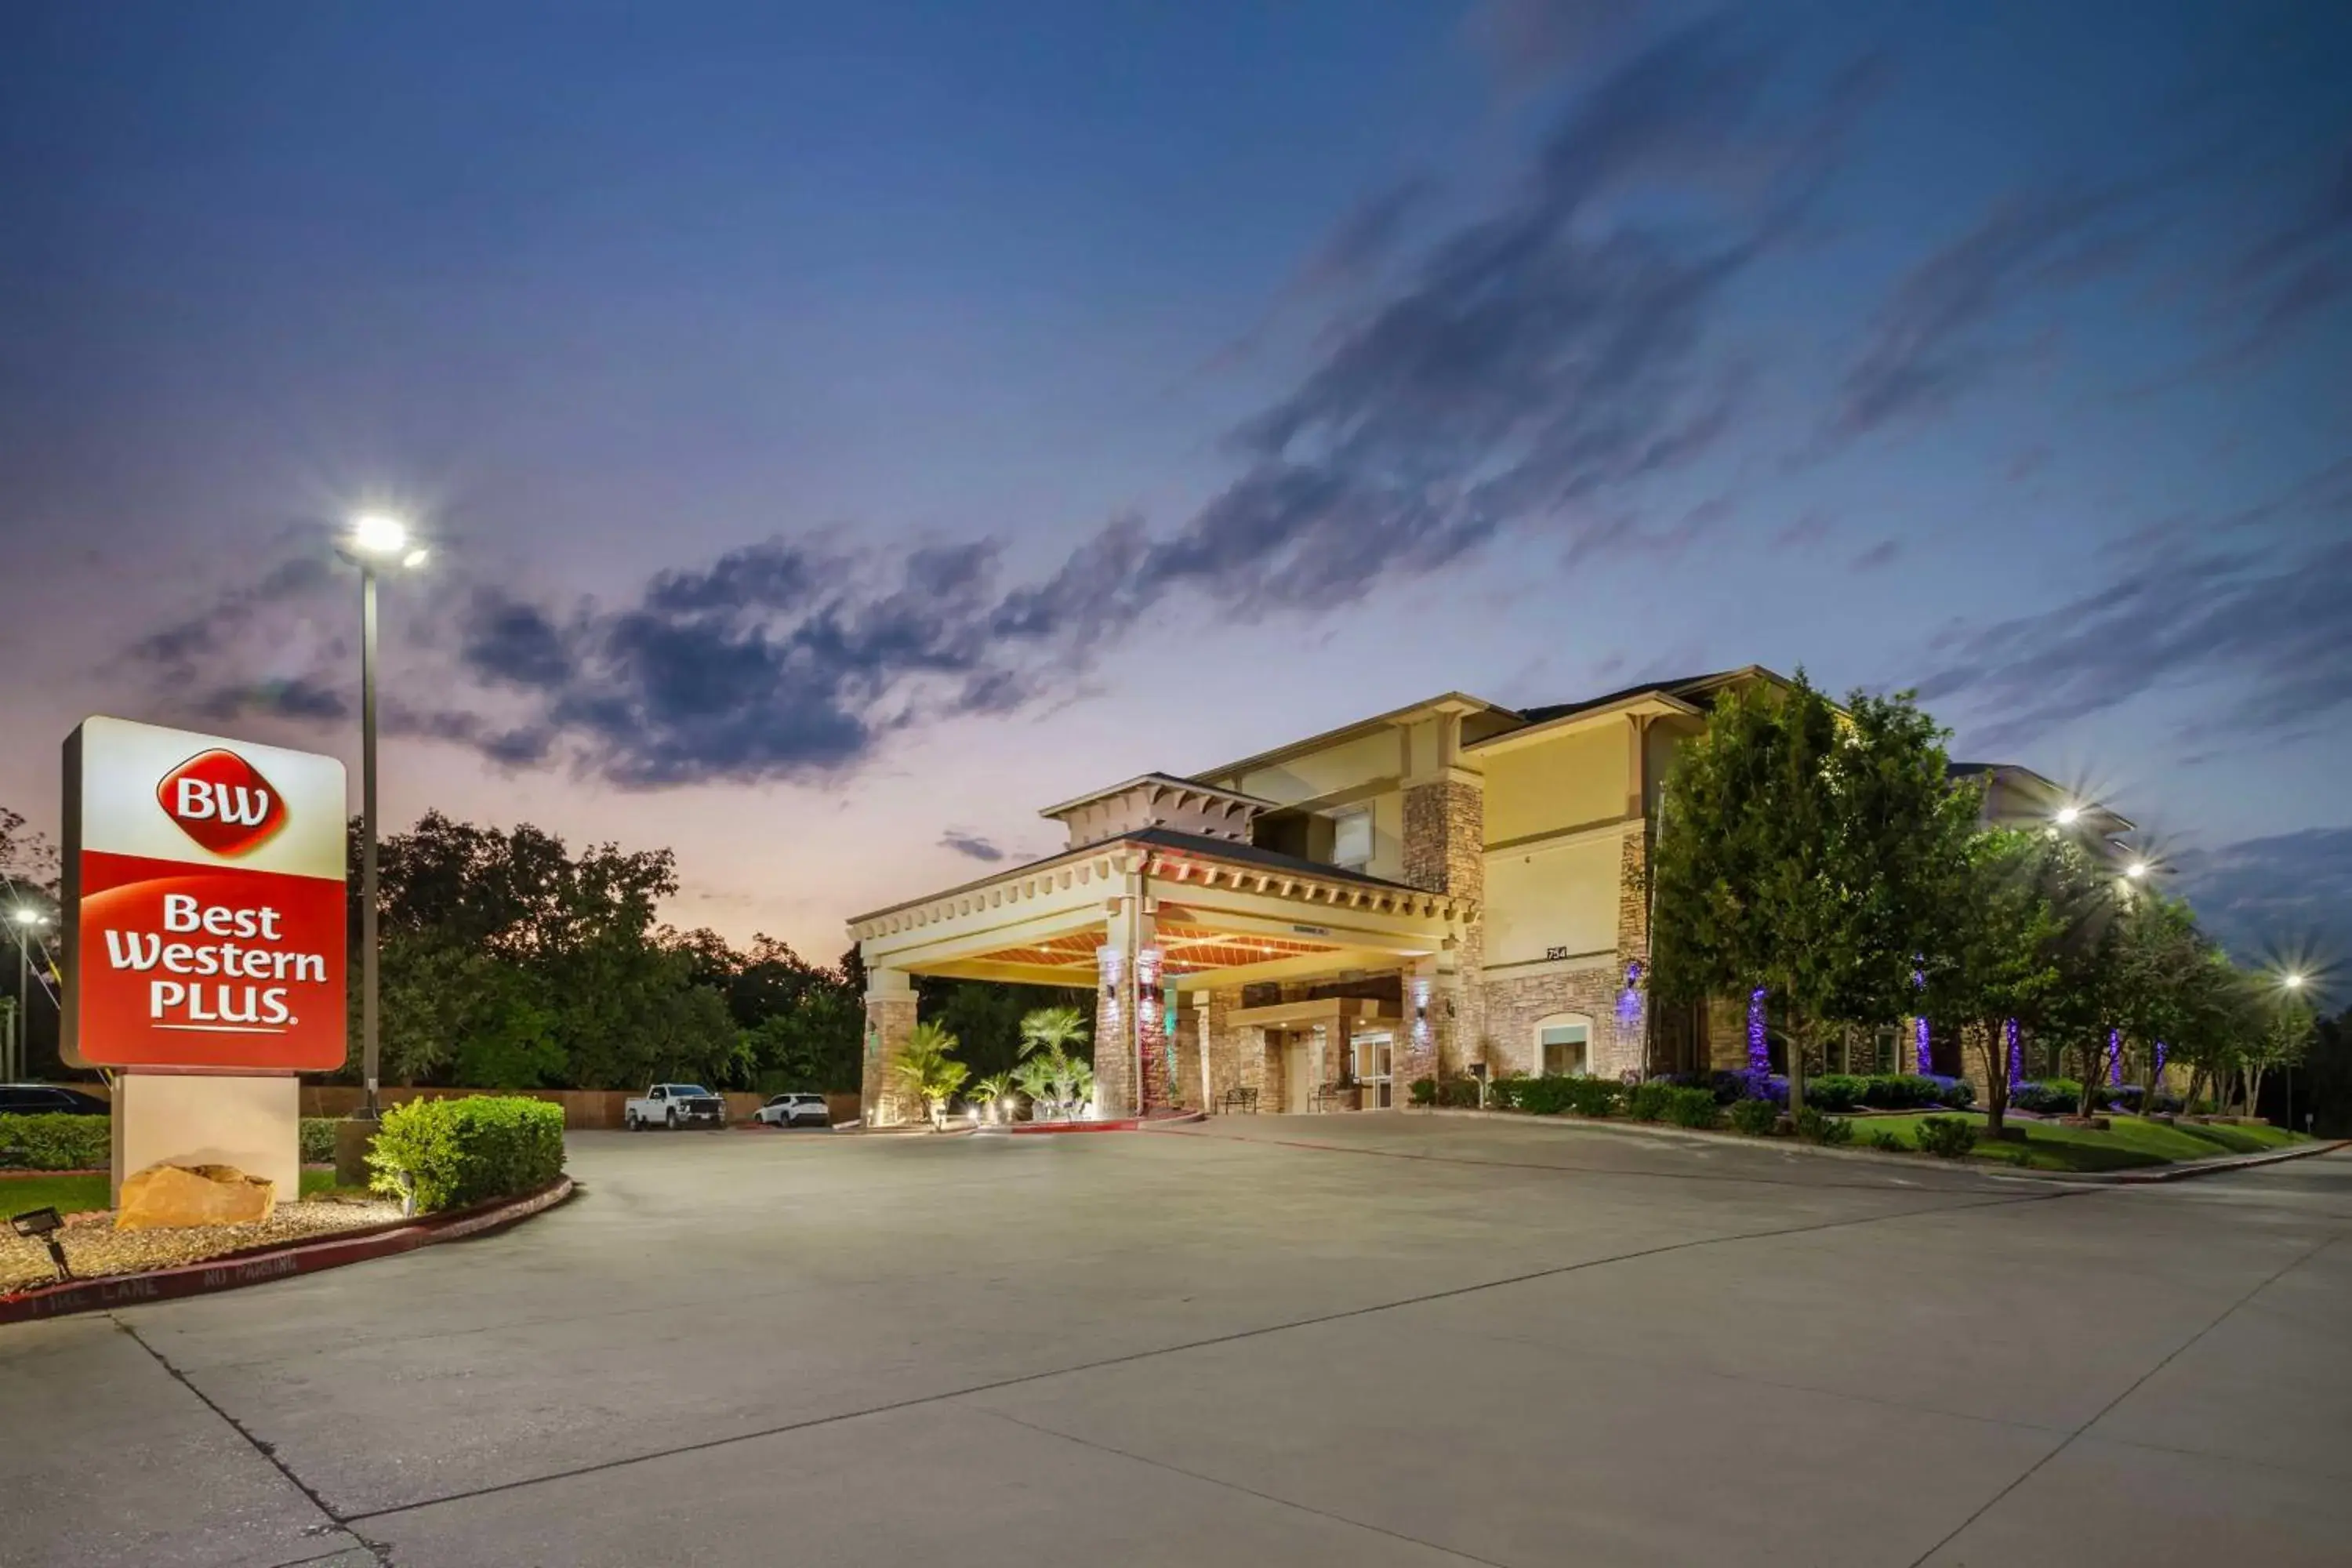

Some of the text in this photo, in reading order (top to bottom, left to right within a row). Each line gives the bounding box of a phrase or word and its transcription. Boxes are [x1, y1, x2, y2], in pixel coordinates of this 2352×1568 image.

[177, 778, 269, 826] BW
[163, 894, 282, 941] Best
[104, 929, 328, 982] Western
[1548, 946, 1565, 960] 754
[102, 1279, 160, 1300] LANE
